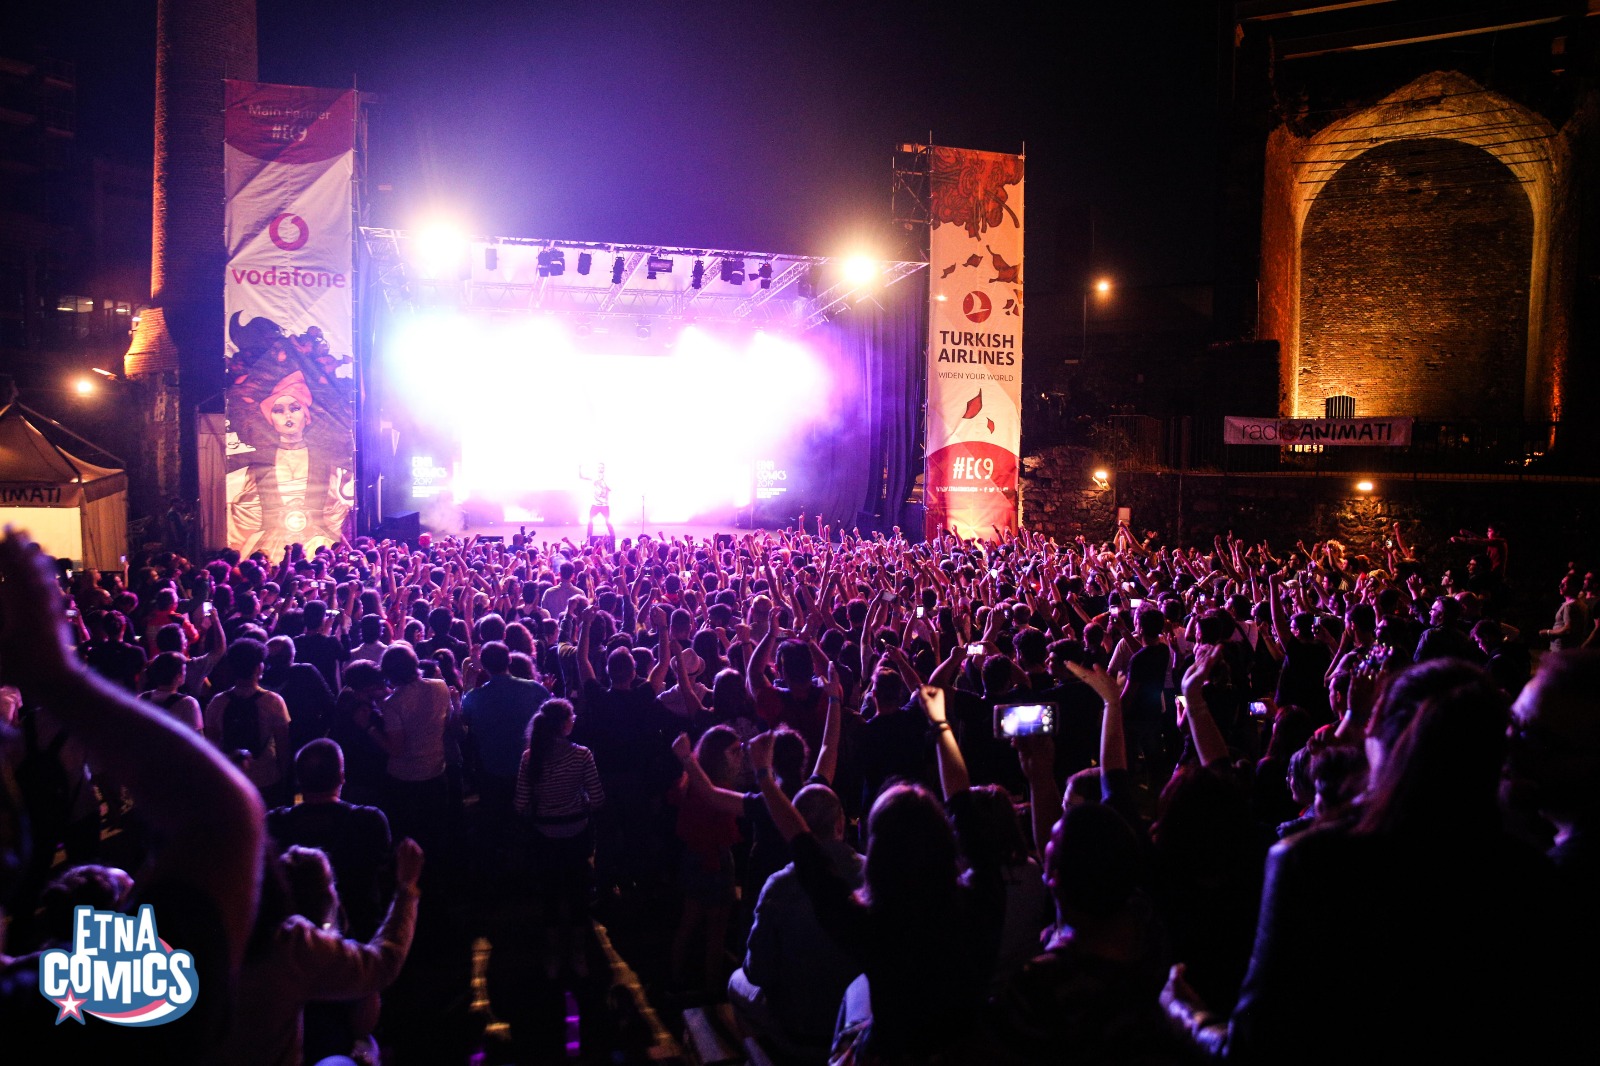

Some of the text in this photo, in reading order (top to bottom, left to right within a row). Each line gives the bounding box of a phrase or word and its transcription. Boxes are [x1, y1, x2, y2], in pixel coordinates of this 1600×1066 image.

[248, 104, 331, 121] Main Partner
[272, 124, 309, 143] #EC9
[231, 265, 346, 288] vodafone
[939, 330, 1014, 349] TURKISH
[938, 348, 1015, 366] AIRLINES
[938, 371, 1014, 382] WIDEN YOUR WORLD
[952, 456, 994, 480] #EC9
